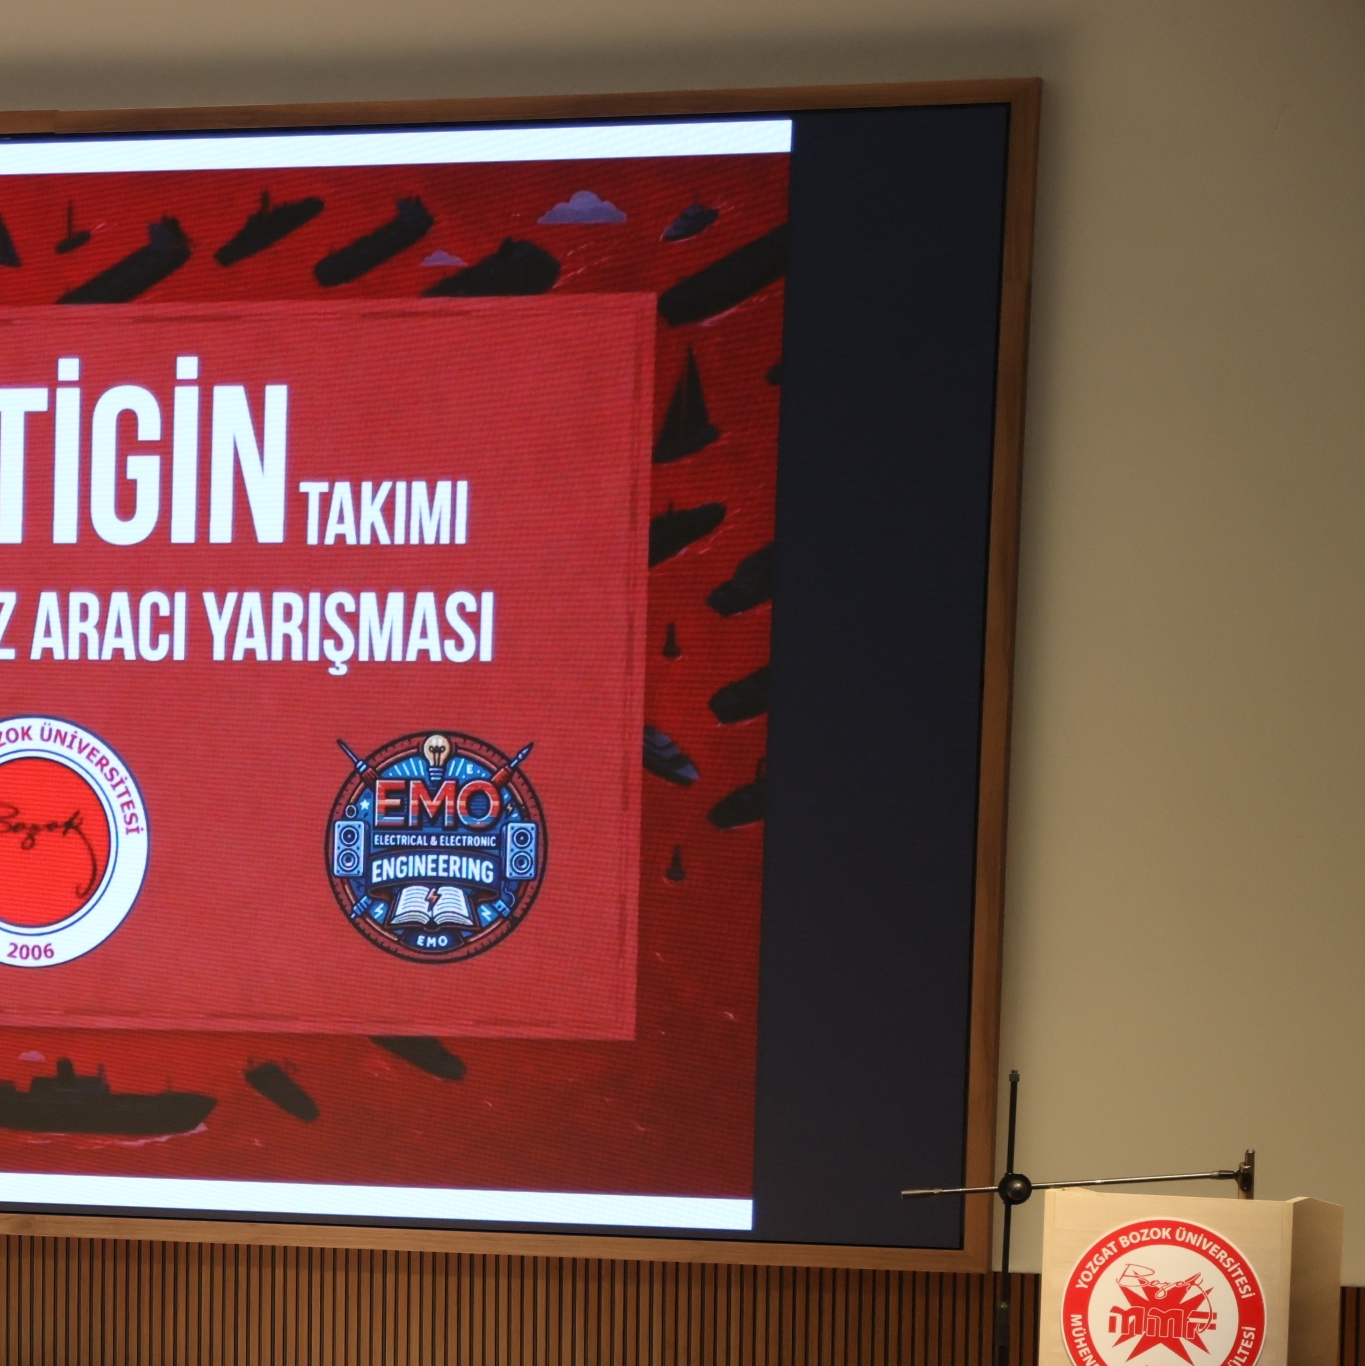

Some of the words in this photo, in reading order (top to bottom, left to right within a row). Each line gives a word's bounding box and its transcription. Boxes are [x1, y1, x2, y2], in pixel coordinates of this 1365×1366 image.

[299, 479, 469, 546] TAKIMI
[30, 590, 187, 662] ARACI
[202, 590, 495, 676] YARIŞMASI
[39, 722, 144, 836] ÜNİVERSİTESİ
[374, 780, 501, 828] EMO
[374, 834, 429, 846] ELECTRICAL
[430, 835, 438, 846] &
[439, 835, 497, 847] ELECTRONIC
[371, 854, 494, 884] ENGINEERING
[6, 942, 55, 961] 2006
[417, 935, 448, 947] EMO
[1075, 1241, 1119, 1291] YOZGAT
[1118, 1227, 1172, 1249] BOZOK
[1175, 1226, 1257, 1300] ÜNİVERSİTESİ
